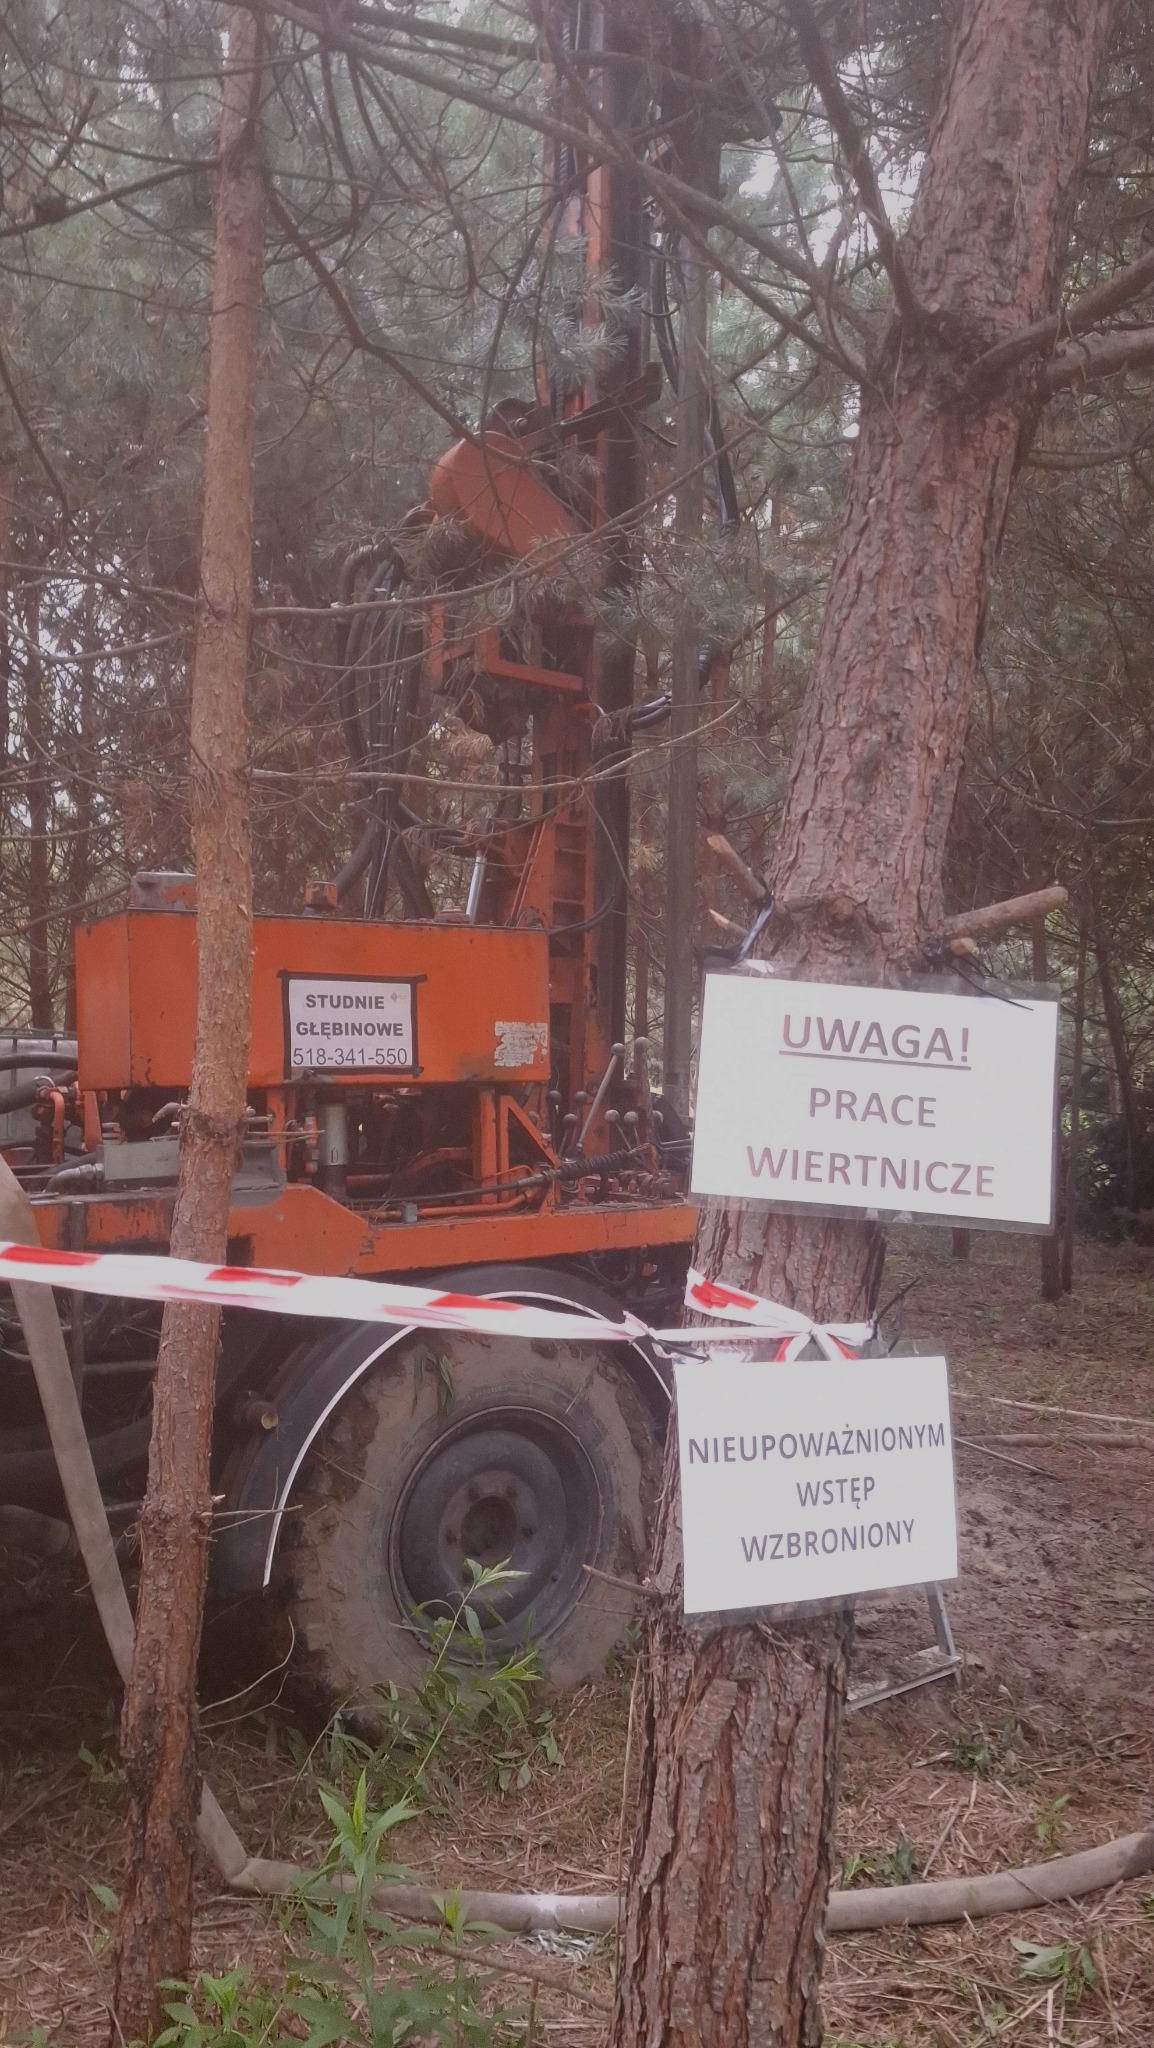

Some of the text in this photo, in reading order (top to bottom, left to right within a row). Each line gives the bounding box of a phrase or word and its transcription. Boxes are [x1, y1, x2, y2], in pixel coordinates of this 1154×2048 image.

[304, 994, 386, 1010] STUDNIE
[295, 1021, 404, 1039] GŁĘBINOWE
[782, 1014, 970, 1063] UWAGA!
[292, 1046, 409, 1066] 518-341-550
[809, 1087, 937, 1128] PRACE
[746, 1145, 996, 1198] WIERTNICZE
[688, 1422, 945, 1464] NIEUPOWAŻNIONYM
[796, 1476, 876, 1510] WSTĘP
[740, 1518, 915, 1562] WZBRONIONY
